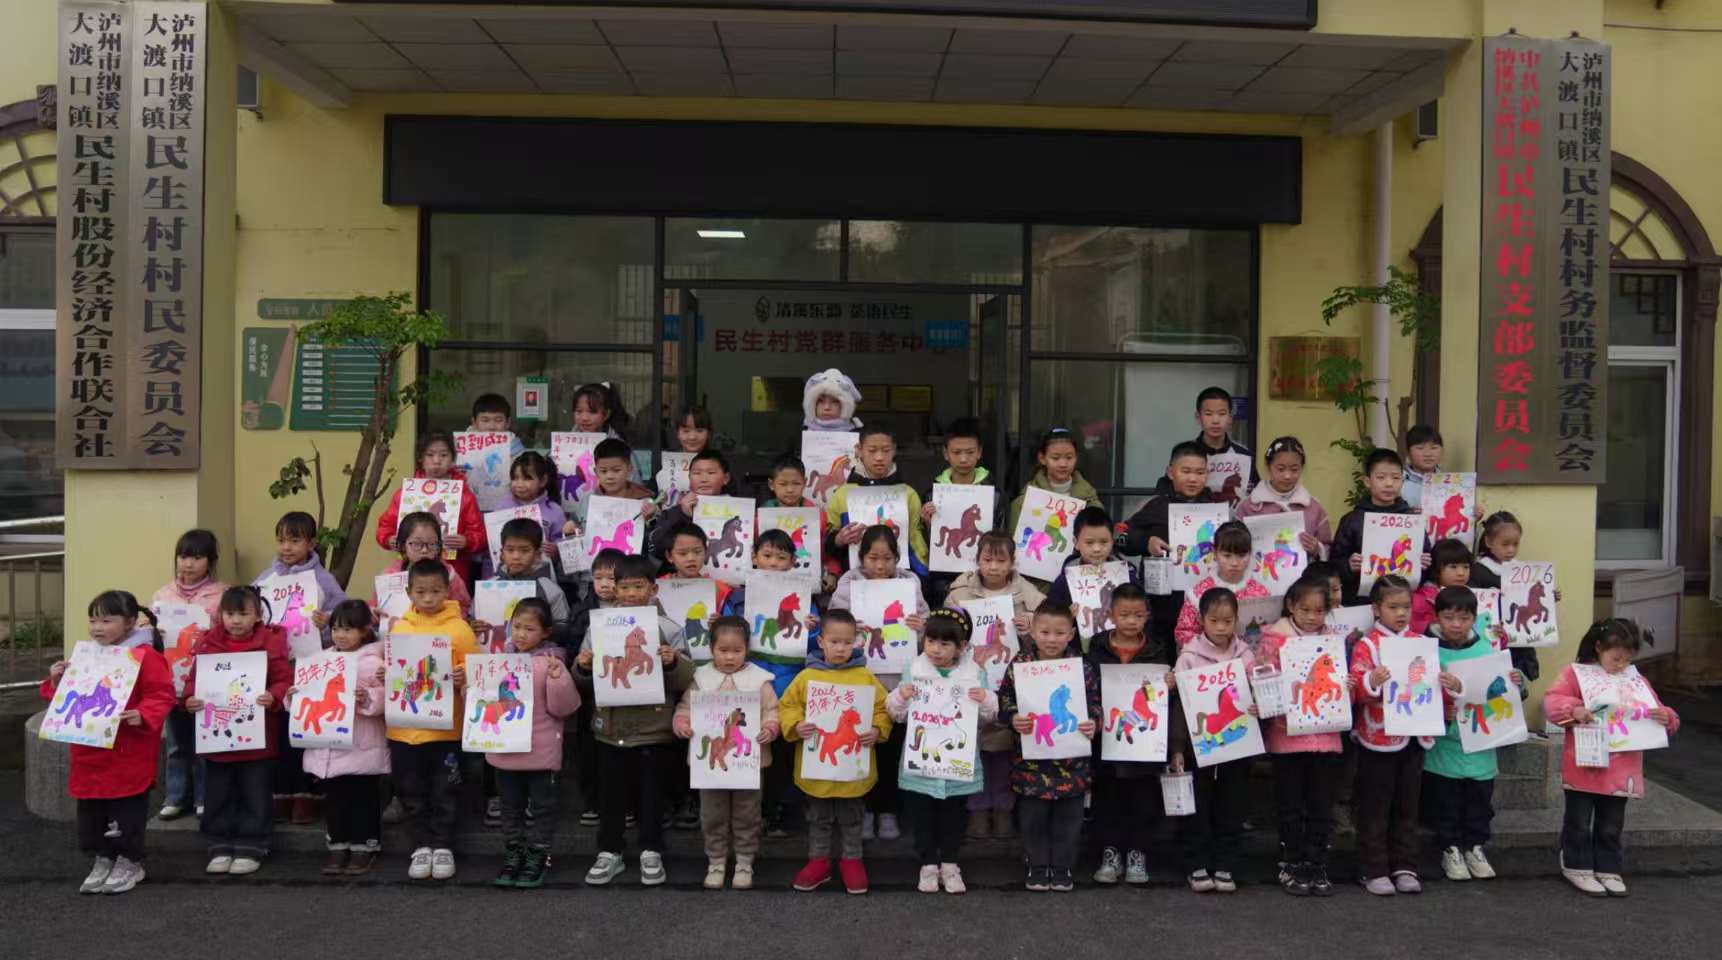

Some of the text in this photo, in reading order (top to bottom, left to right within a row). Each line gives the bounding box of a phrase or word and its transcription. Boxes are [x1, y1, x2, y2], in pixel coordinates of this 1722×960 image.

[68, 12, 94, 129] 大渡口镇
[97, 13, 122, 130] 泸州市纳溪区
[142, 13, 168, 130] 大渡口镇
[169, 13, 196, 130] 泸州市纳溪区
[1557, 51, 1580, 162] 大渡口镇
[1582, 52, 1604, 163] 泸州市纳溪区
[70, 134, 117, 458] 民生村股份经济合作联合社
[140, 135, 191, 457] 民生村村民委员会
[715, 329, 948, 354] 民生村党群服务中
[1555, 167, 1600, 472] 民生村村务监督委员会
[1046, 495, 1085, 516] 202
[1209, 461, 1241, 473] 2026
[1380, 516, 1413, 528] 2026
[811, 686, 837, 697] 2026
[1197, 663, 1236, 692] 2026
